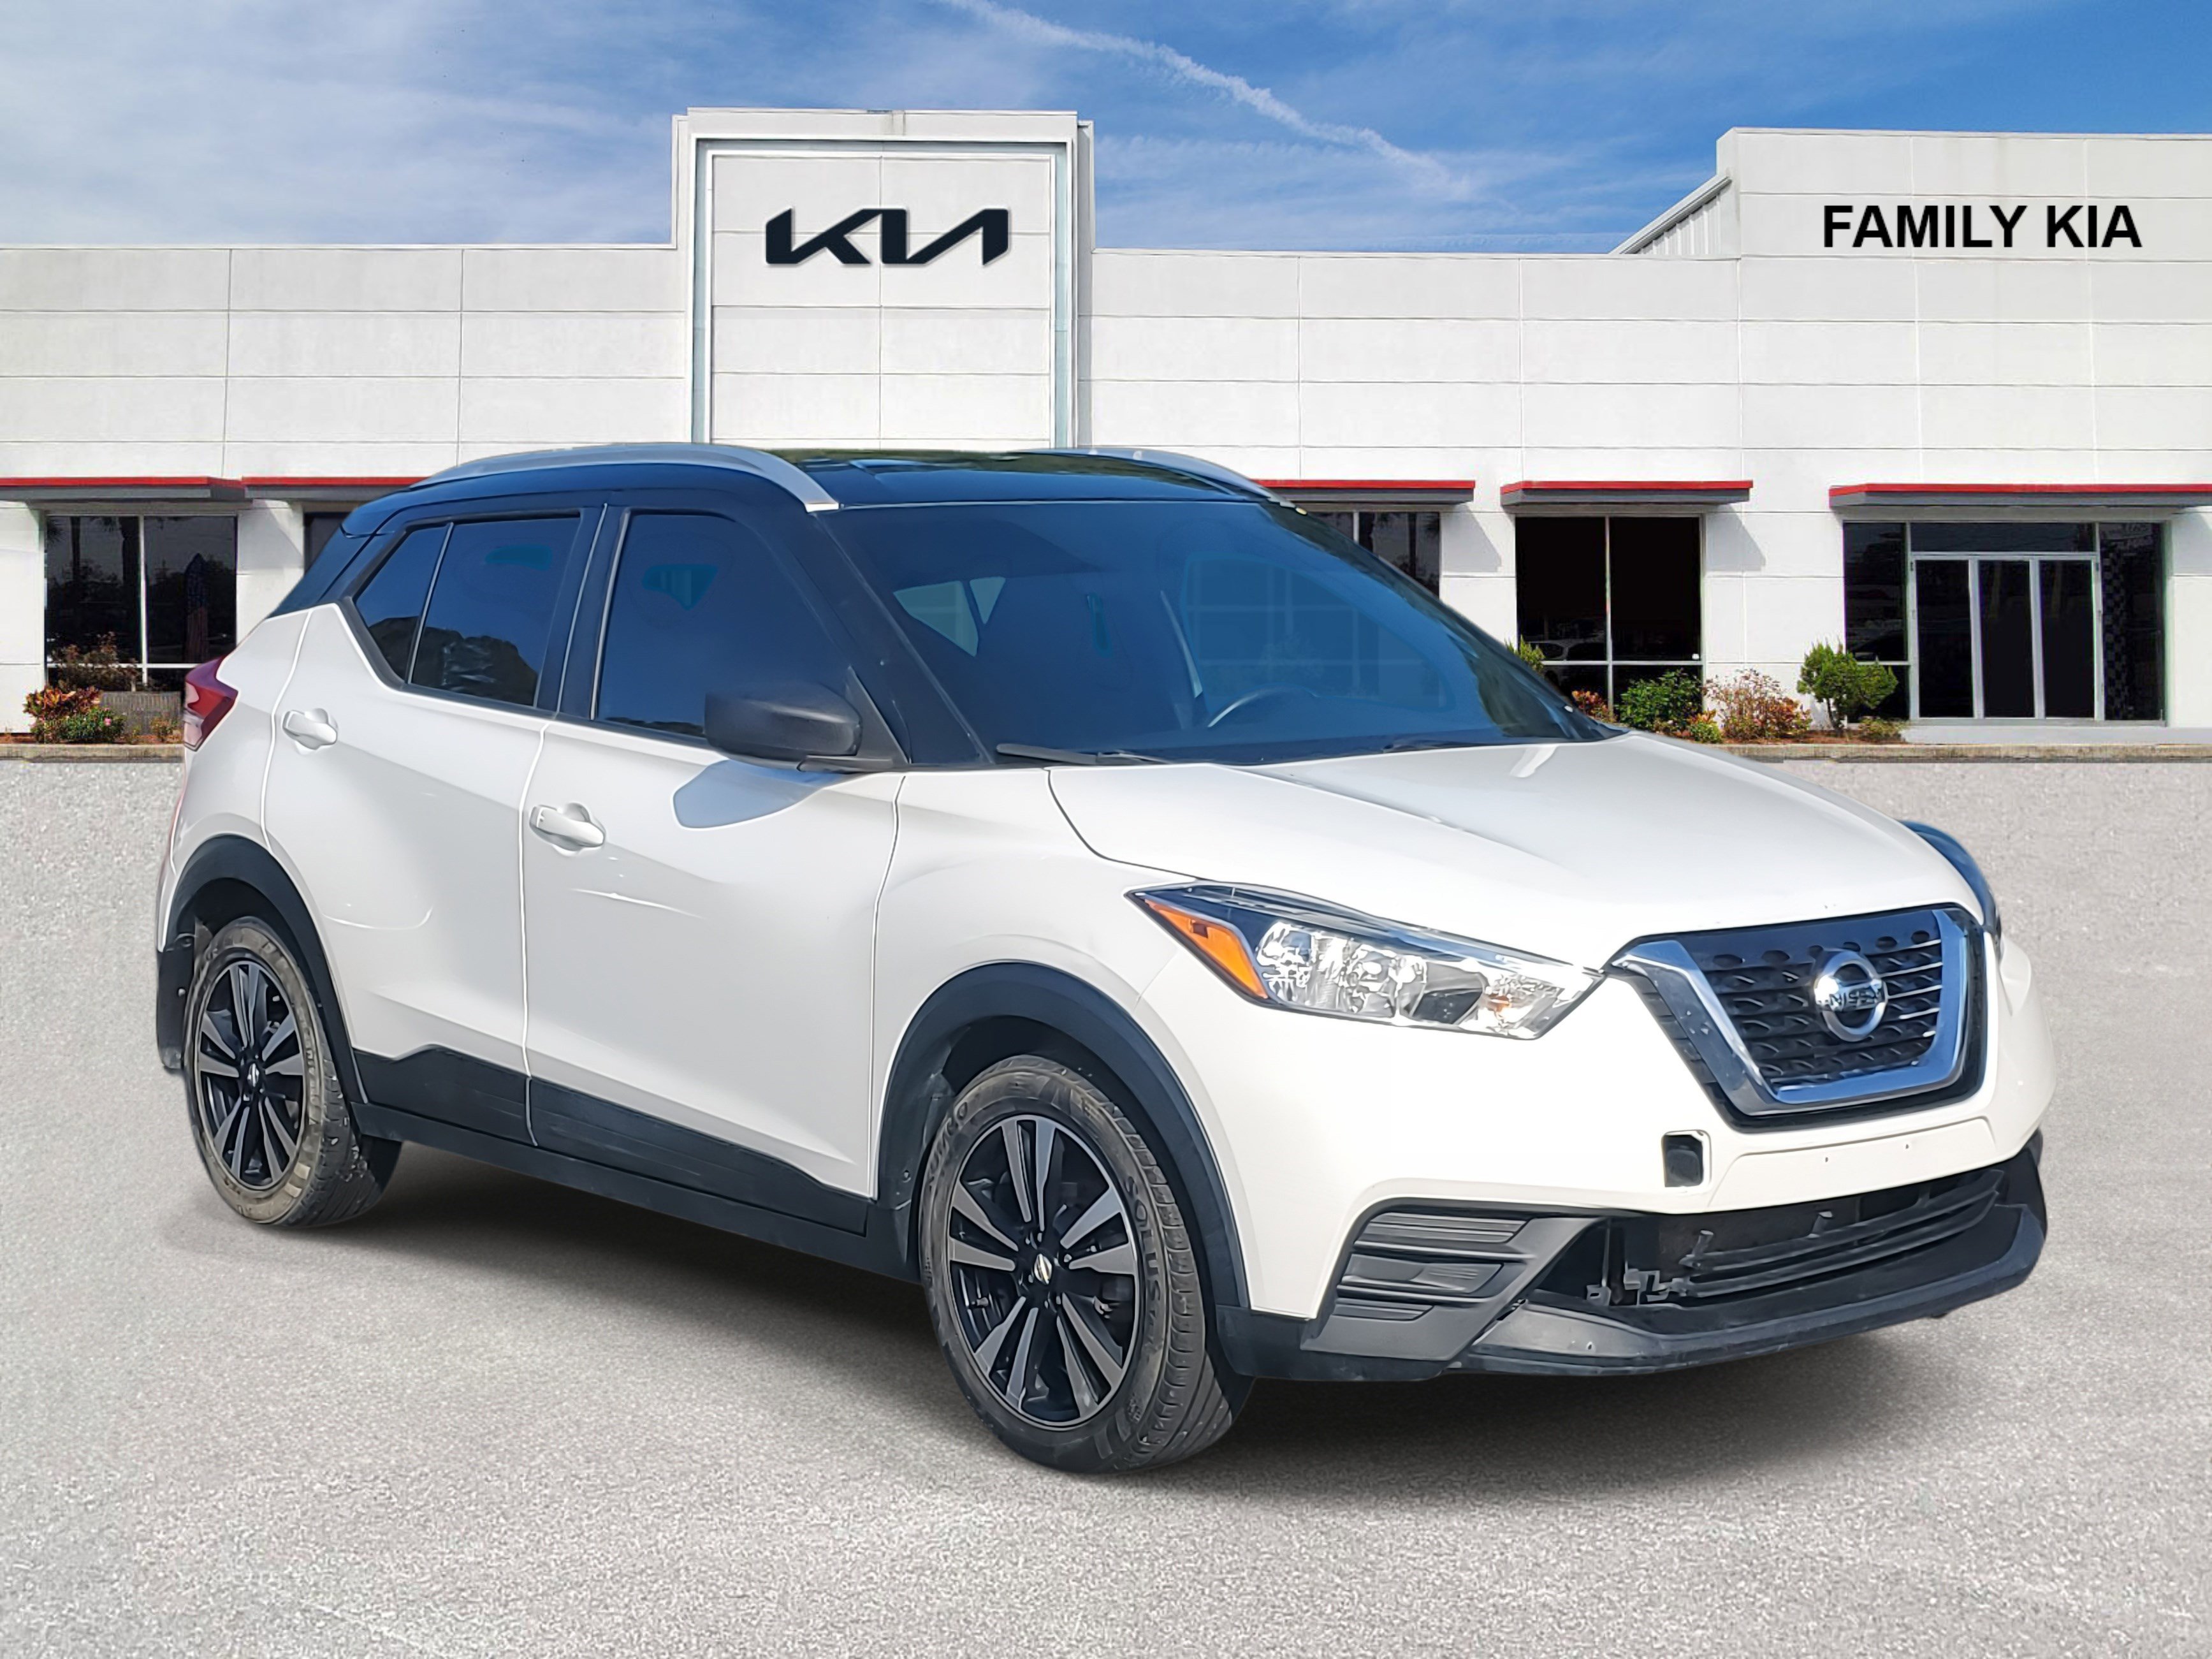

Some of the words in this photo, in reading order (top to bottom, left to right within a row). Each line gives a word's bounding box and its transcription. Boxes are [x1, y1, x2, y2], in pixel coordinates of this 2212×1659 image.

[766, 208, 1009, 265] KIA
[1824, 205, 2028, 248] FAMILY
[2047, 205, 2143, 248] KIA
[1124, 1175, 1161, 1302] SOLUS
